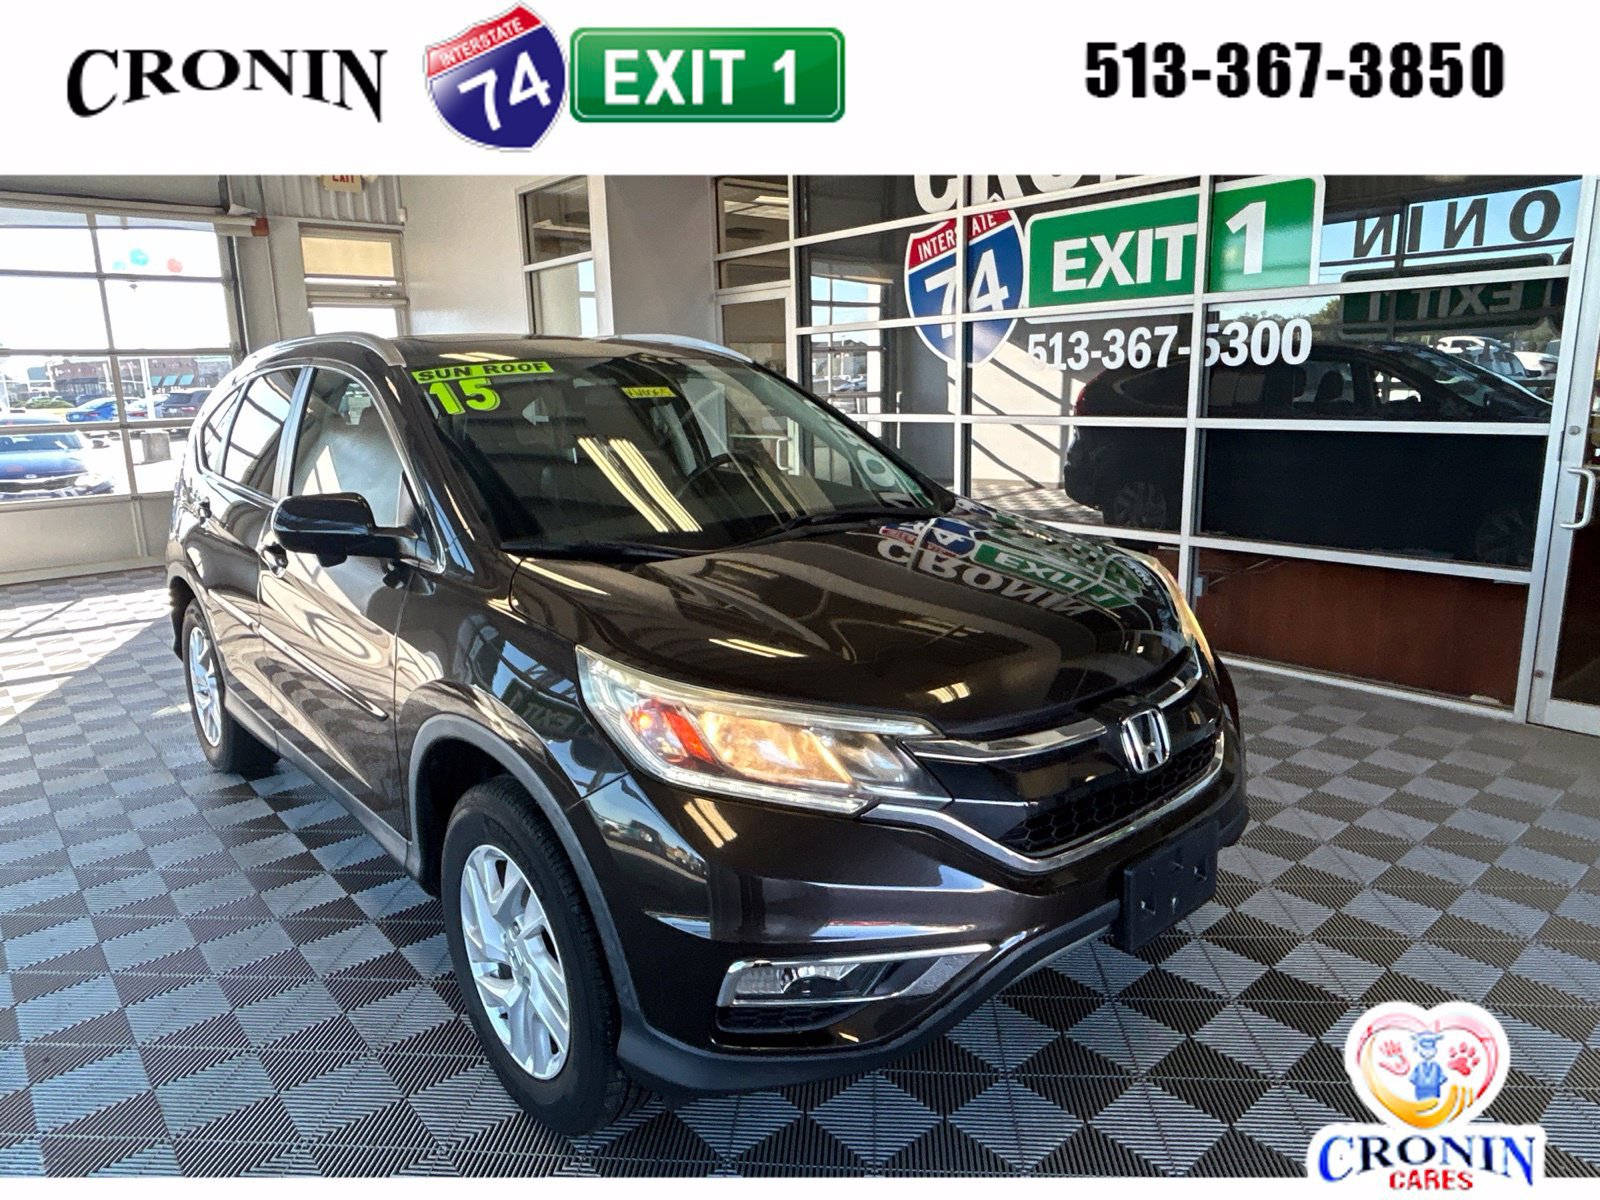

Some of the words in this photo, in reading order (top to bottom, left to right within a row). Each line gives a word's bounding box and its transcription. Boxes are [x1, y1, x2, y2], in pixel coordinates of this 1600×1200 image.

[1052, 221, 1199, 292] EXIT
[1225, 200, 1267, 275] 1
[924, 248, 1010, 340] 74
[418, 367, 471, 381] SUN
[483, 362, 548, 375] ROOF
[1027, 318, 1313, 372] 513-367-5300
[429, 378, 500, 415] 15
